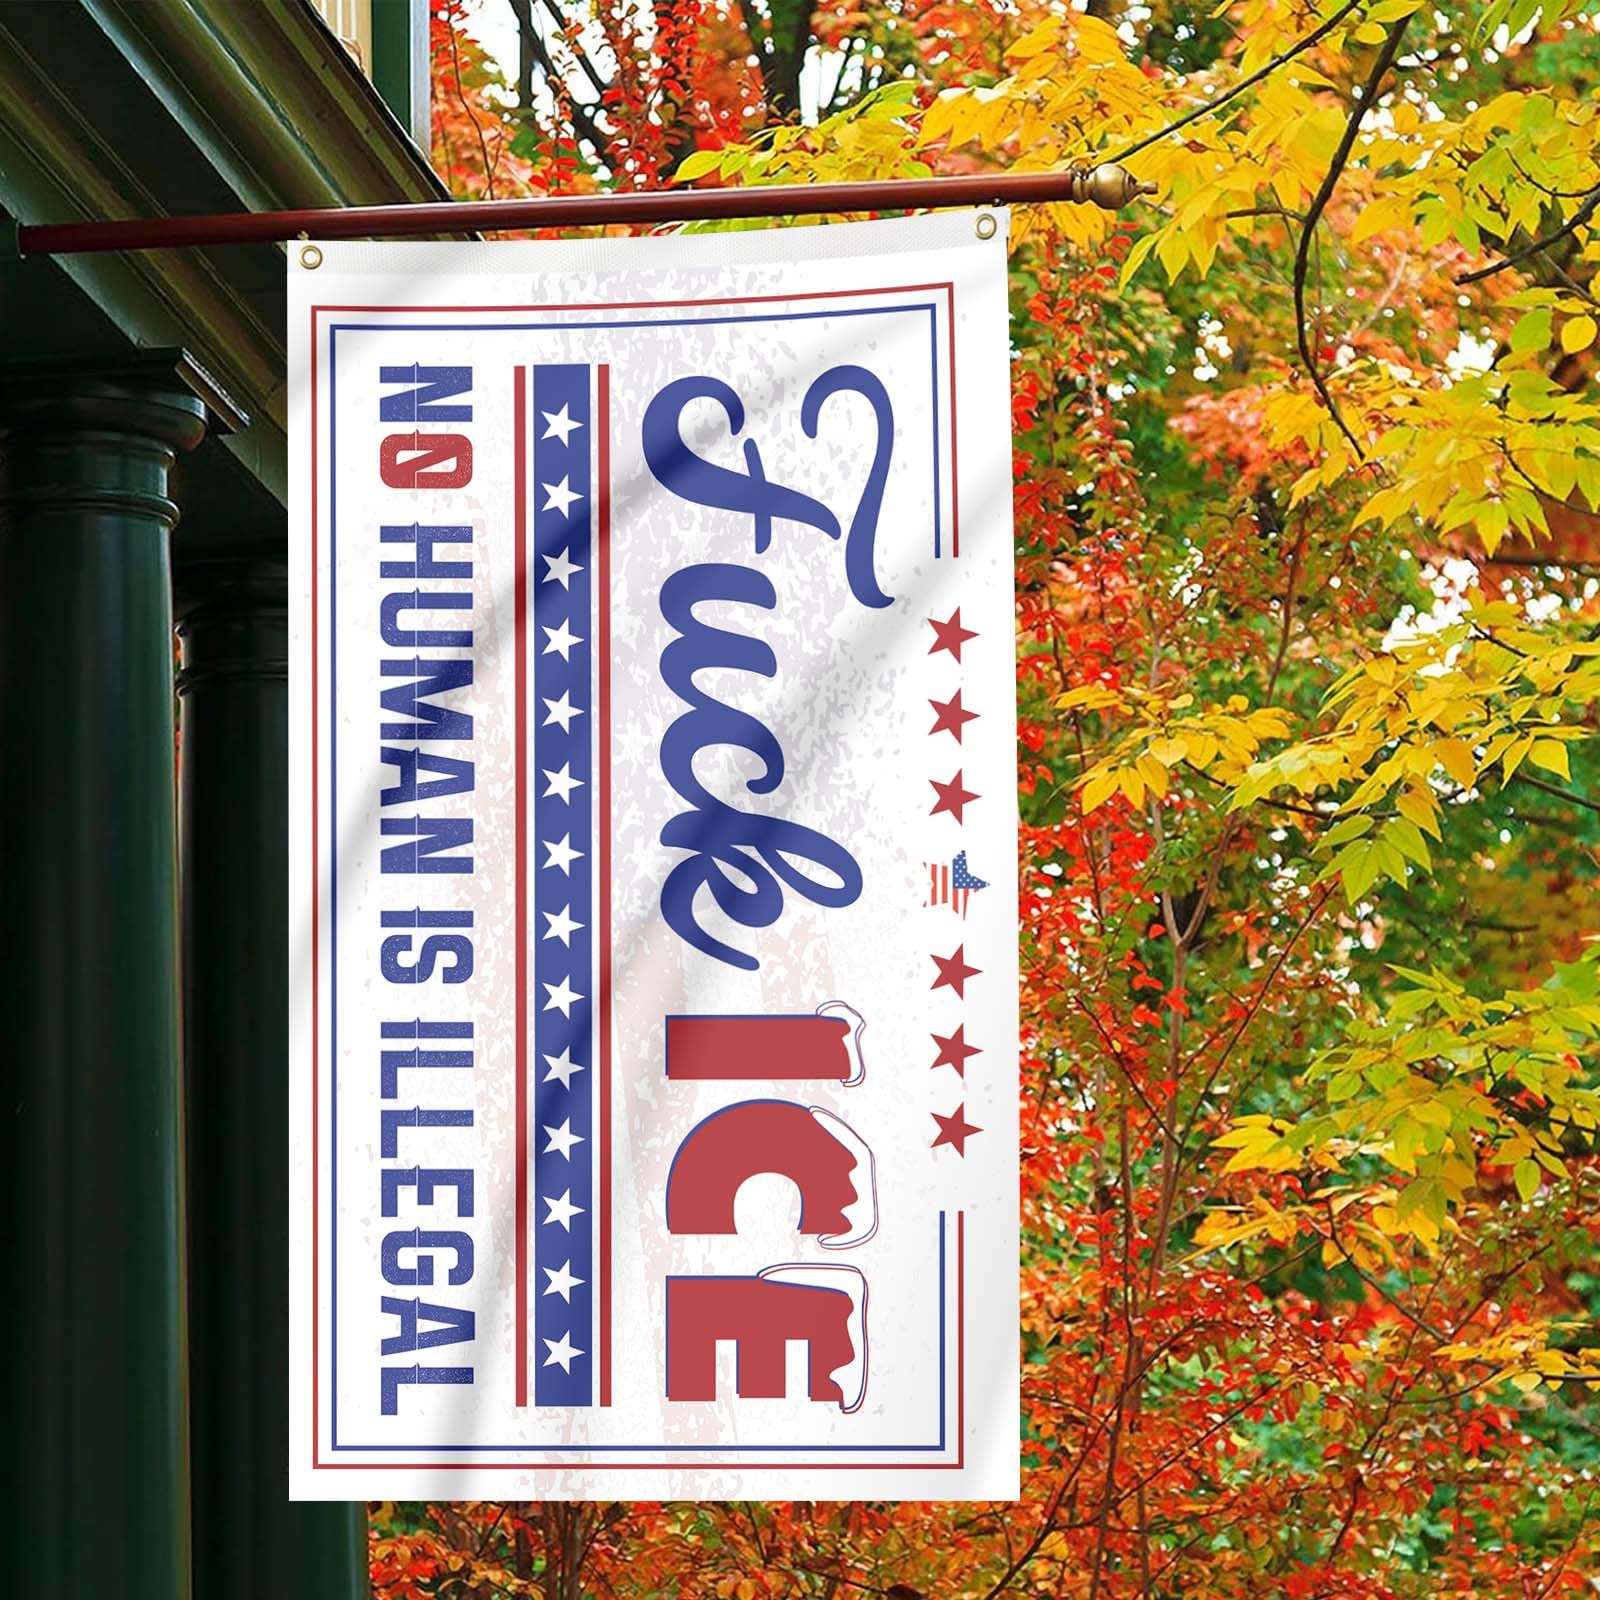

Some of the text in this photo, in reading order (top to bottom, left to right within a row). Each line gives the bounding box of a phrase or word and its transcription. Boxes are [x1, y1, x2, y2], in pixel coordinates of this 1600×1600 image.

[379, 522, 474, 874] HUMAN
[380, 906, 474, 985] IS
[642, 364, 895, 1415] Fuck ICE
[380, 1017, 475, 1416] ILLEGAL
